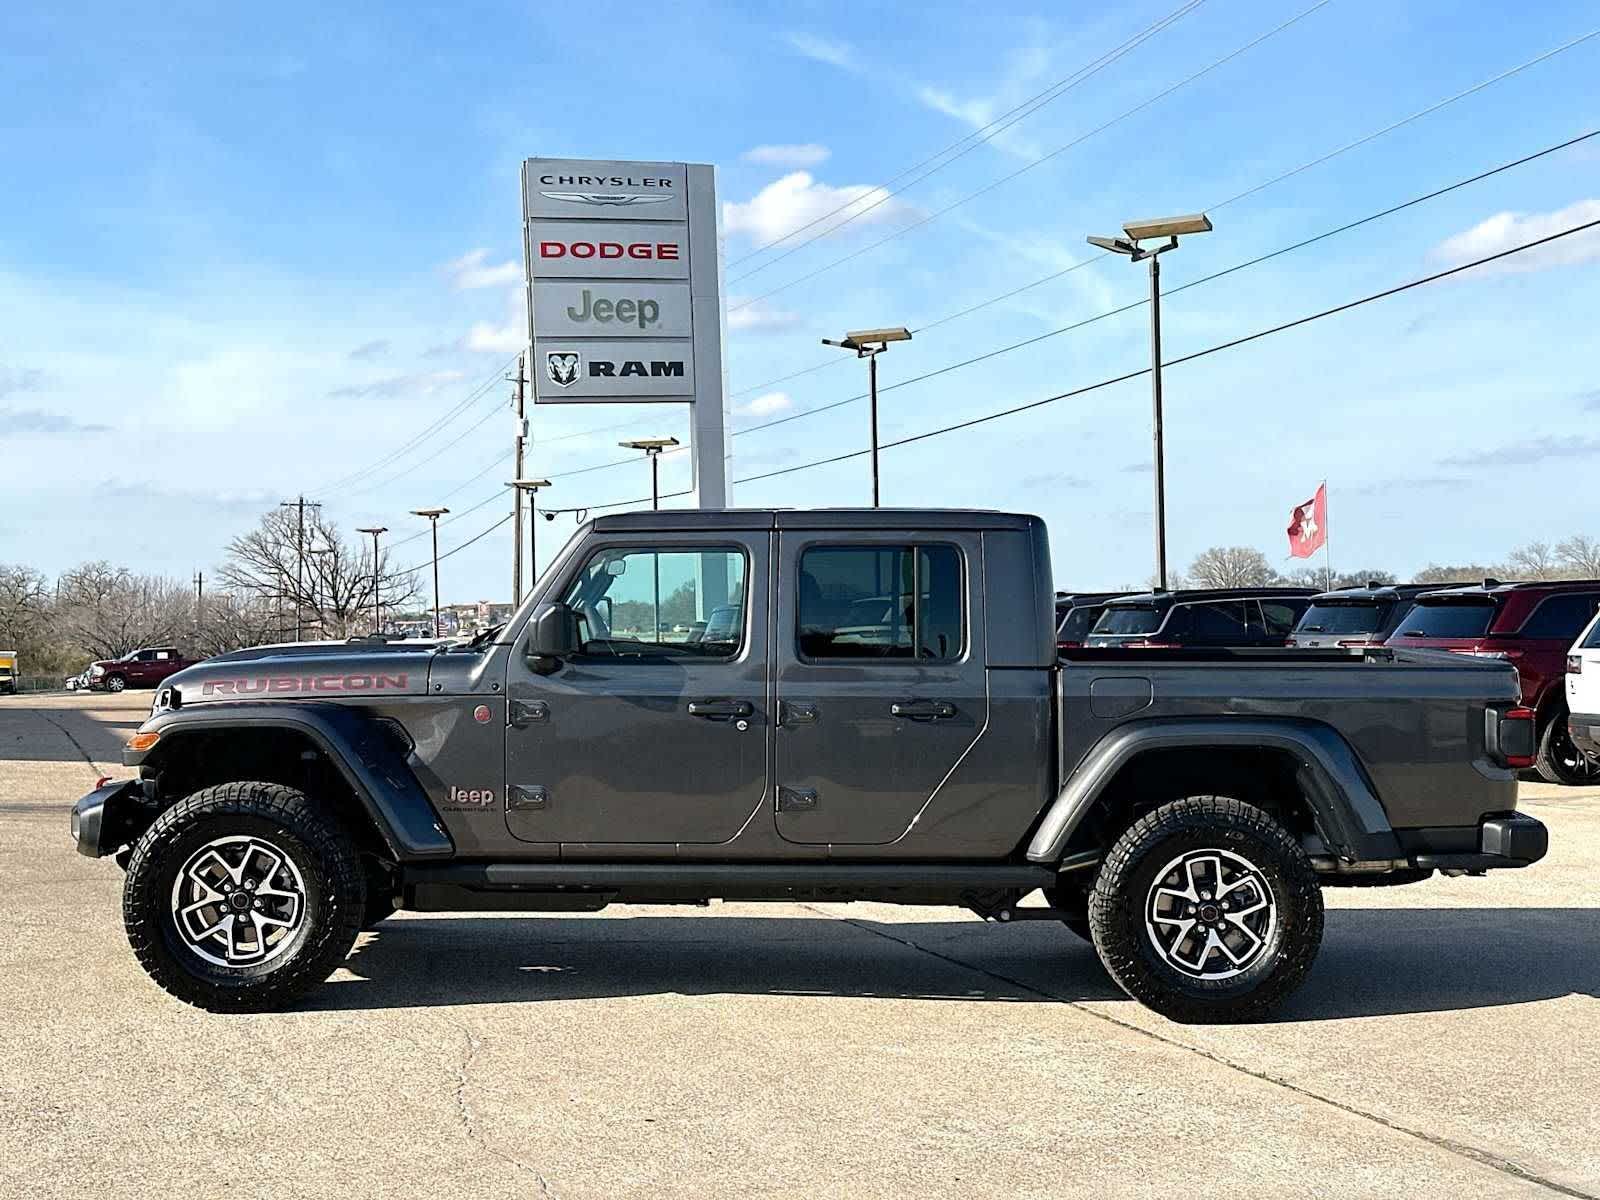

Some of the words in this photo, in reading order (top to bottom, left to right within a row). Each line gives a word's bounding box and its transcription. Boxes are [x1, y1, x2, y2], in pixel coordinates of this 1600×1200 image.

[540, 175, 673, 188] CHRYSLER
[540, 242, 680, 260] DODGE
[567, 289, 660, 329] Jeep
[588, 361, 685, 377] RAM
[202, 672, 408, 696] RUBICON
[447, 785, 494, 806] Jeep
